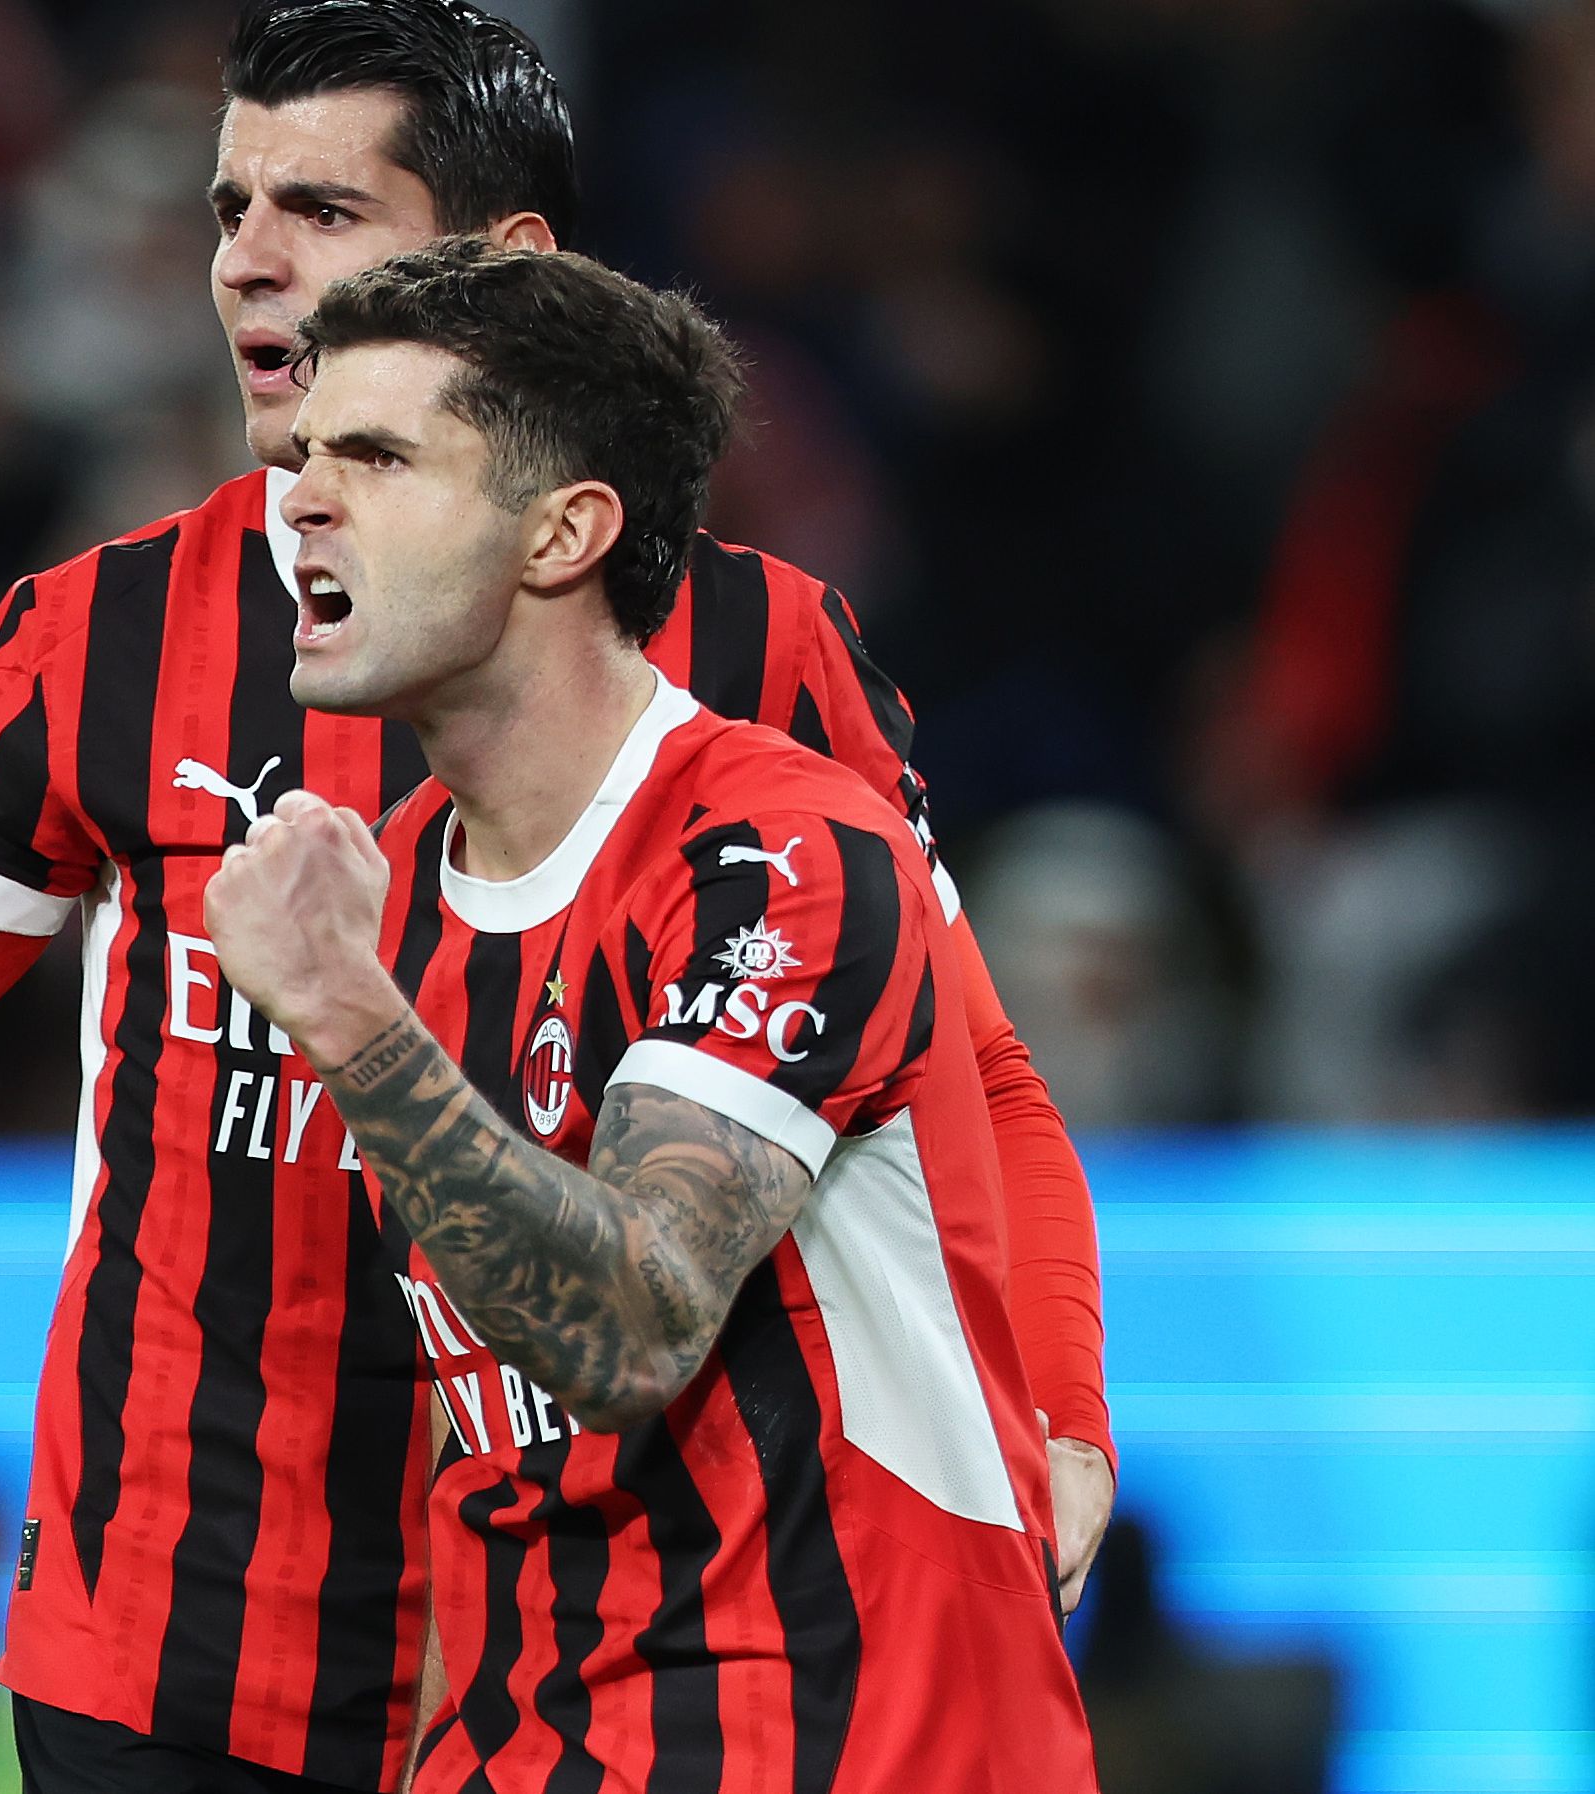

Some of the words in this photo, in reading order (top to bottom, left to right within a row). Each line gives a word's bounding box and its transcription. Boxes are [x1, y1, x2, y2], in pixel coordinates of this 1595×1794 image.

[538, 1022, 567, 1044] ACM
[659, 983, 826, 1063] MSC
[215, 1070, 324, 1163] FLY
[534, 1111, 558, 1127] 1899
